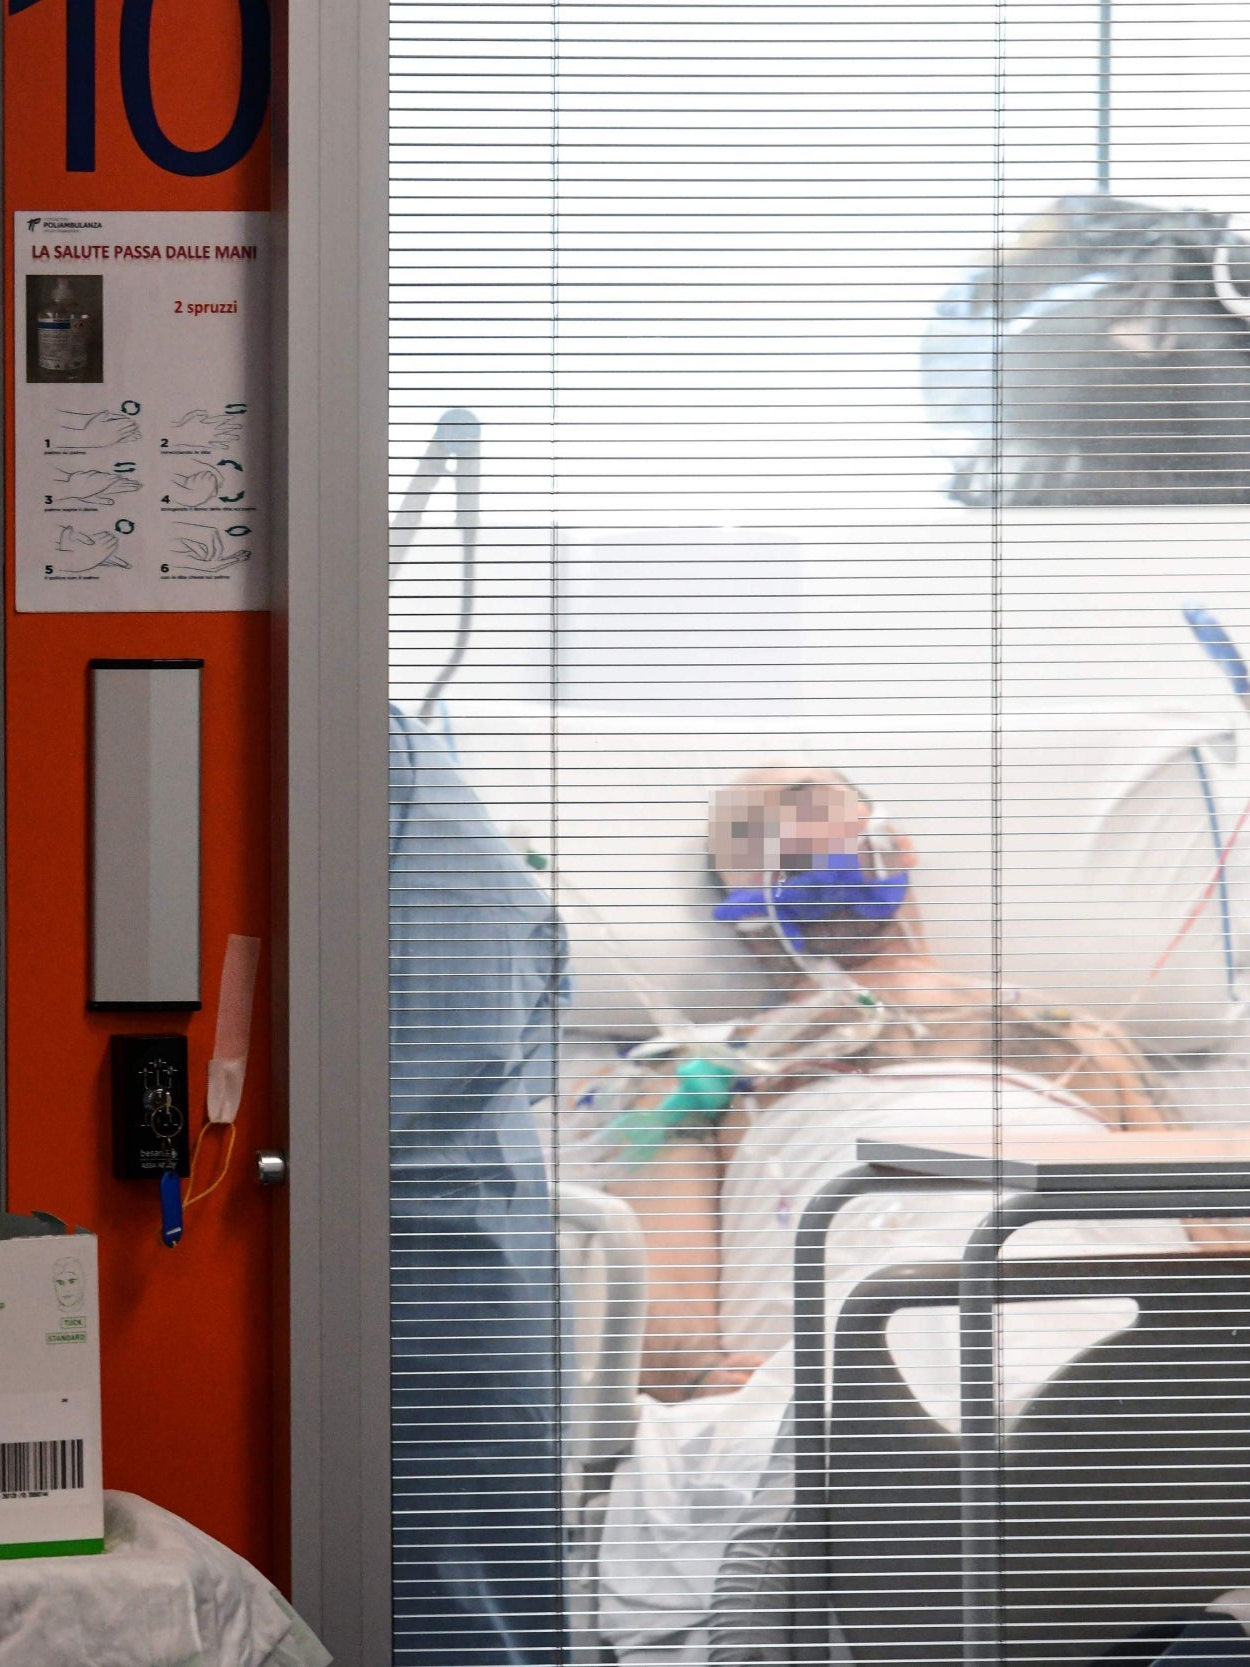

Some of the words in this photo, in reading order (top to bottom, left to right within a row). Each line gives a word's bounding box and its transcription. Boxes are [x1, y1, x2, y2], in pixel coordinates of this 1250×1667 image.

[9, 0, 271, 177] 10
[43, 221, 103, 229] POLIAMBULANZA
[32, 245, 50, 260] LA
[54, 245, 110, 260] SALUTE
[114, 245, 162, 260] PASSA
[166, 245, 211, 260] DALLE
[215, 245, 257, 260] MANI
[174, 300, 183, 314] 2
[187, 300, 238, 316] spruzzi
[44, 439, 51, 448] 1
[160, 439, 169, 448] 2
[44, 495, 53, 505] 3
[160, 495, 170, 504] 4
[44, 565, 53, 574] 5
[160, 563, 169, 573] 6
[47, 1333, 86, 1343] STANDARD
